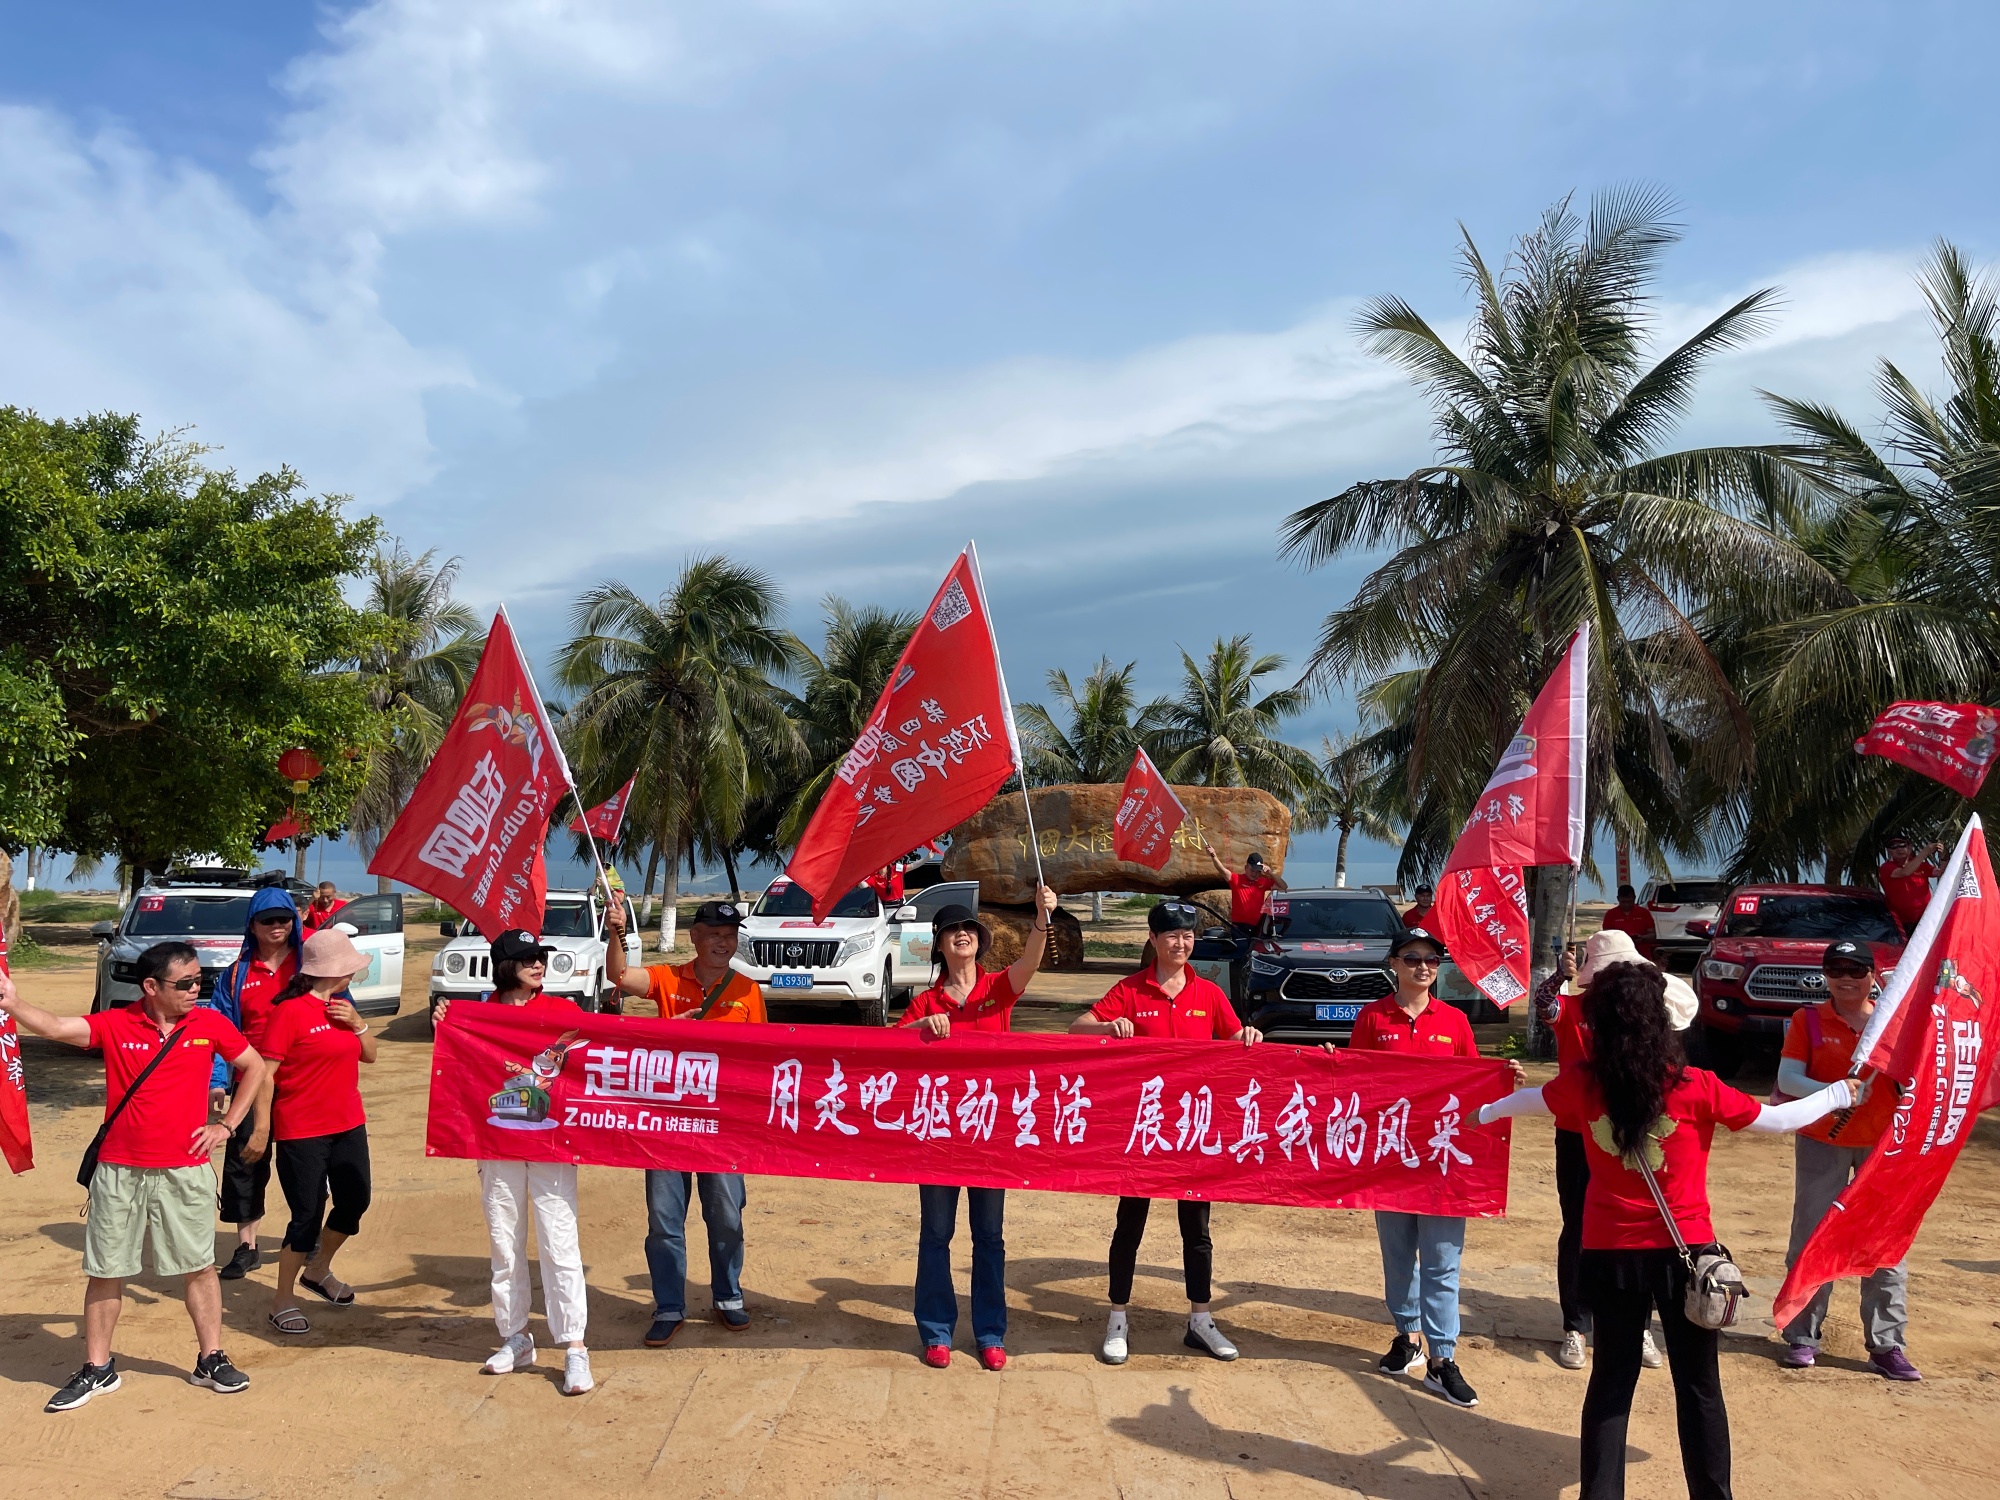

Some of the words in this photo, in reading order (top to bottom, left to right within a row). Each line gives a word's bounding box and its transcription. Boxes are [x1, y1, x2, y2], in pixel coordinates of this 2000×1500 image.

[1740, 902, 1755, 911] 10
[584, 1046, 720, 1104] 走吧网
[1931, 1003, 1948, 1102] Zouba.Cn
[1937, 1019, 1983, 1146] 走吧网
[564, 1107, 662, 1133] Zouba.Cn
[665, 1116, 719, 1135] 说走就走
[767, 1058, 1092, 1148] 用走吧驱动生活
[1125, 1075, 1473, 1177] 展现真我的风采
